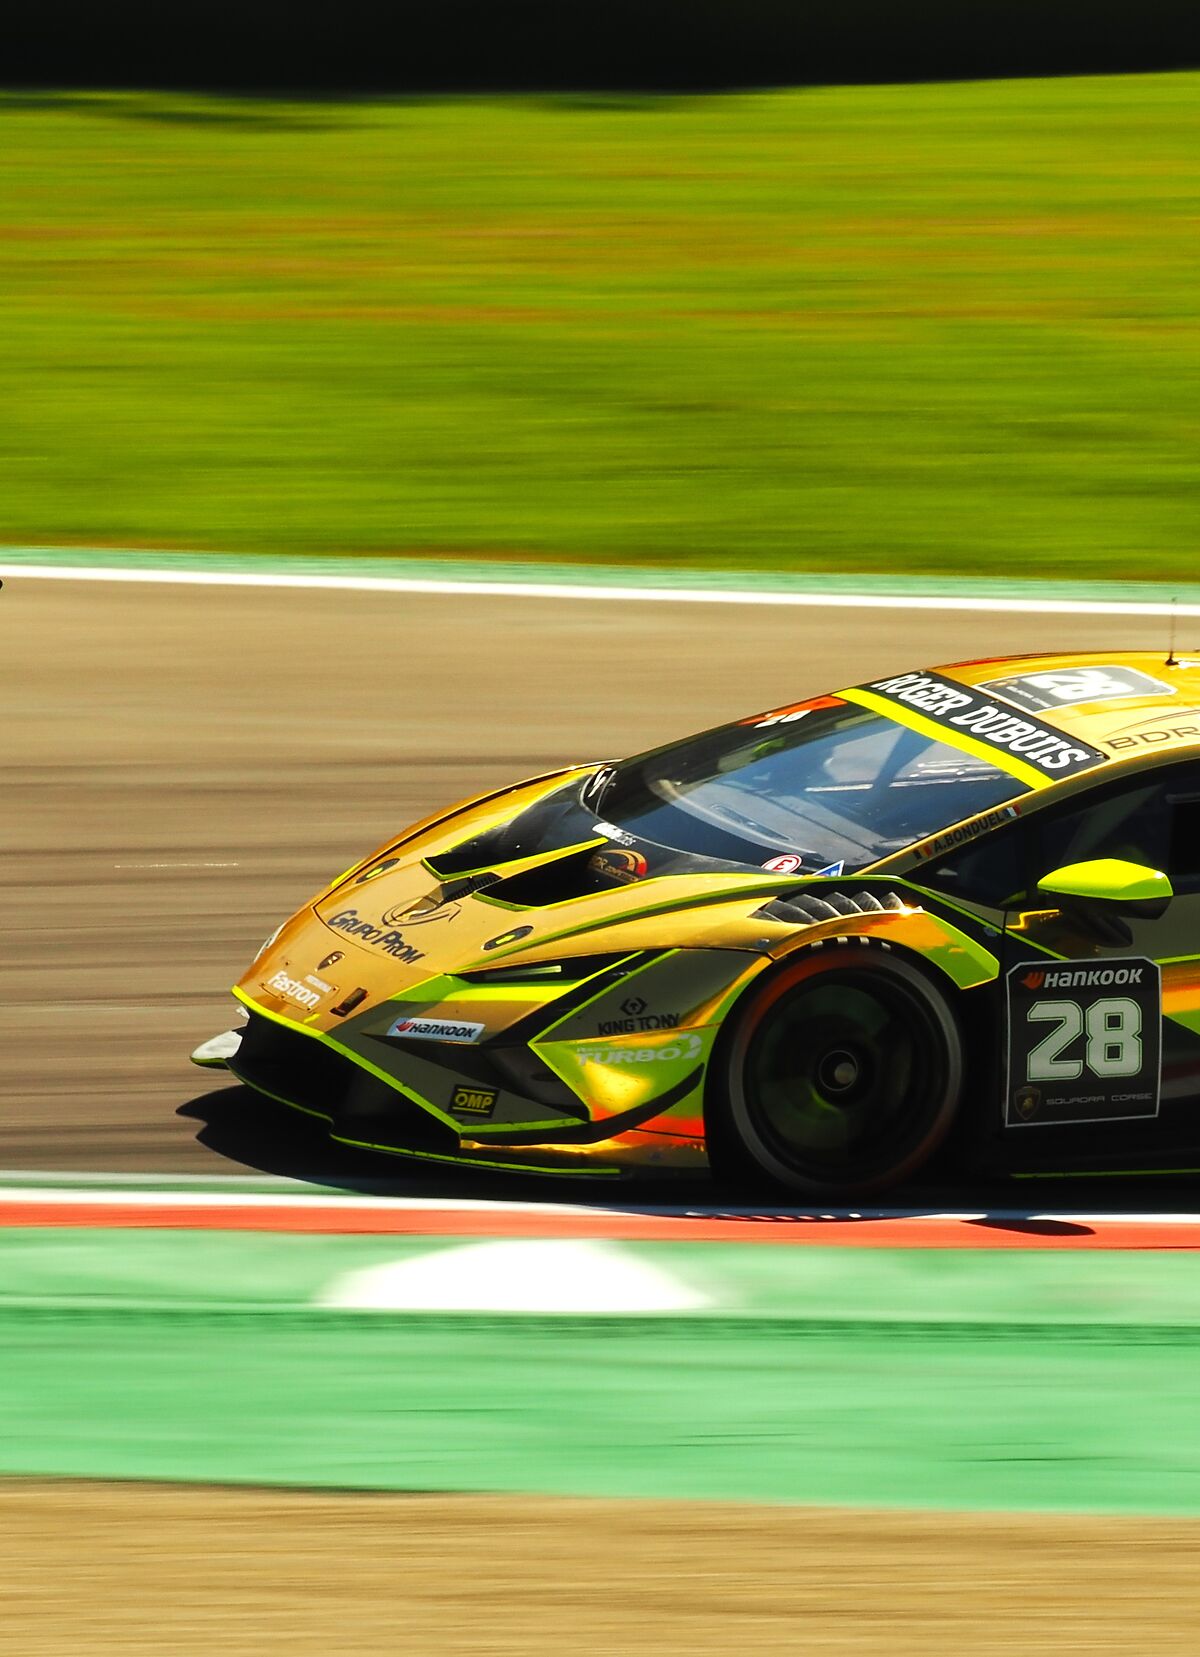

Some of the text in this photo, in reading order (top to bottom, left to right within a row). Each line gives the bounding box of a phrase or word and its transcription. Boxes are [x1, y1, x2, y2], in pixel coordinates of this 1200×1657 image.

[1020, 670, 1135, 700] 28
[870, 674, 973, 716] ROGER
[949, 705, 1090, 769] DUBUIS
[327, 909, 426, 965] GRUPO PROM
[267, 970, 321, 1007] Fastron
[598, 1013, 680, 1036] KING TONY
[1027, 997, 1142, 1082] 28
[455, 1092, 494, 1109] OMP
[1046, 1092, 1153, 1105] SQUADRA CORSE
